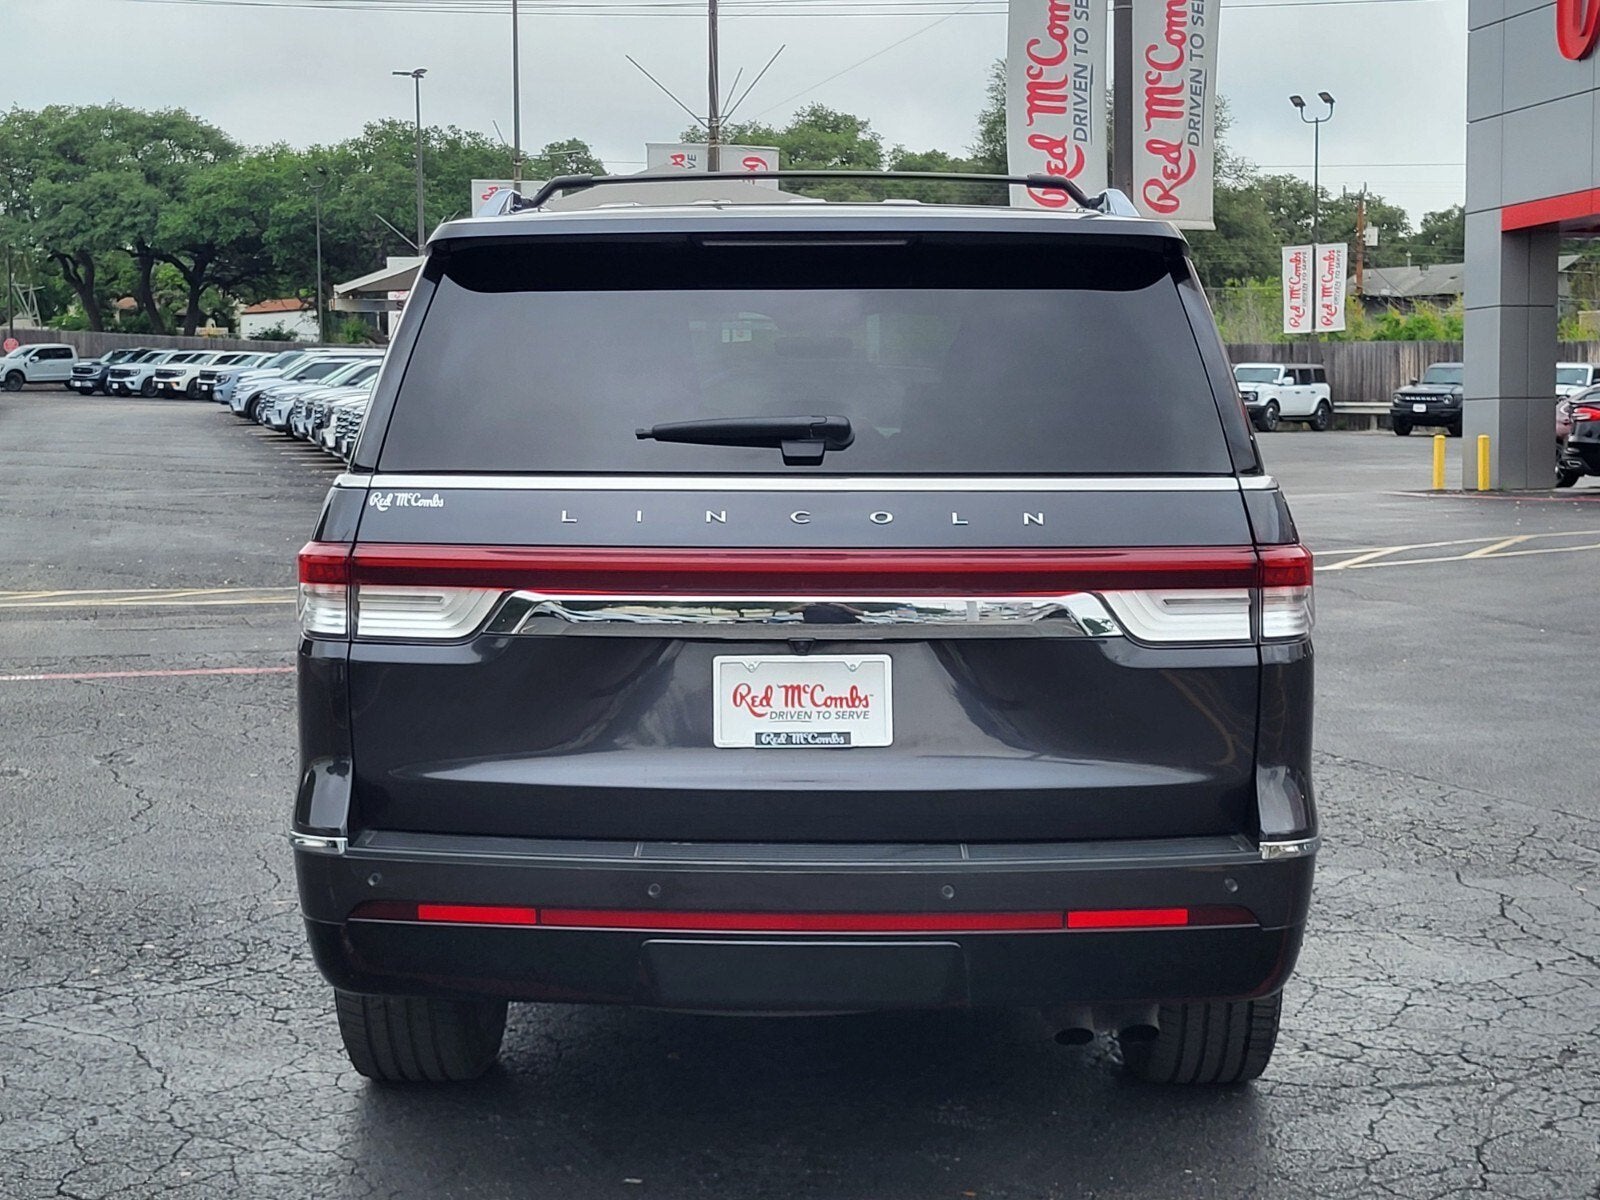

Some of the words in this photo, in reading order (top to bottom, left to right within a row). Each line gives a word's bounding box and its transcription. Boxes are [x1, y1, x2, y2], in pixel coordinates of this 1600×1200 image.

[1073, 28, 1089, 56] TO
[1189, 33, 1205, 62] TO
[1073, 63, 1090, 143] DRIVEN
[1187, 69, 1204, 147] DRIVEN
[1142, 138, 1196, 214] Red
[1289, 251, 1302, 301] McCombs
[1321, 249, 1336, 300] McCombs
[1289, 305, 1305, 328] Red
[1321, 303, 1338, 327] Red
[369, 491, 394, 512] Red
[394, 492, 445, 508] McCombs
[561, 510, 1045, 526] LINCOLN
[732, 683, 774, 718] Red
[777, 684, 870, 709] McCombs
[769, 710, 813, 720] DRIVEN
[816, 710, 832, 720] TO
[834, 710, 870, 720] SERVE
[761, 732, 787, 745] Red
[789, 732, 845, 744] McCombs
